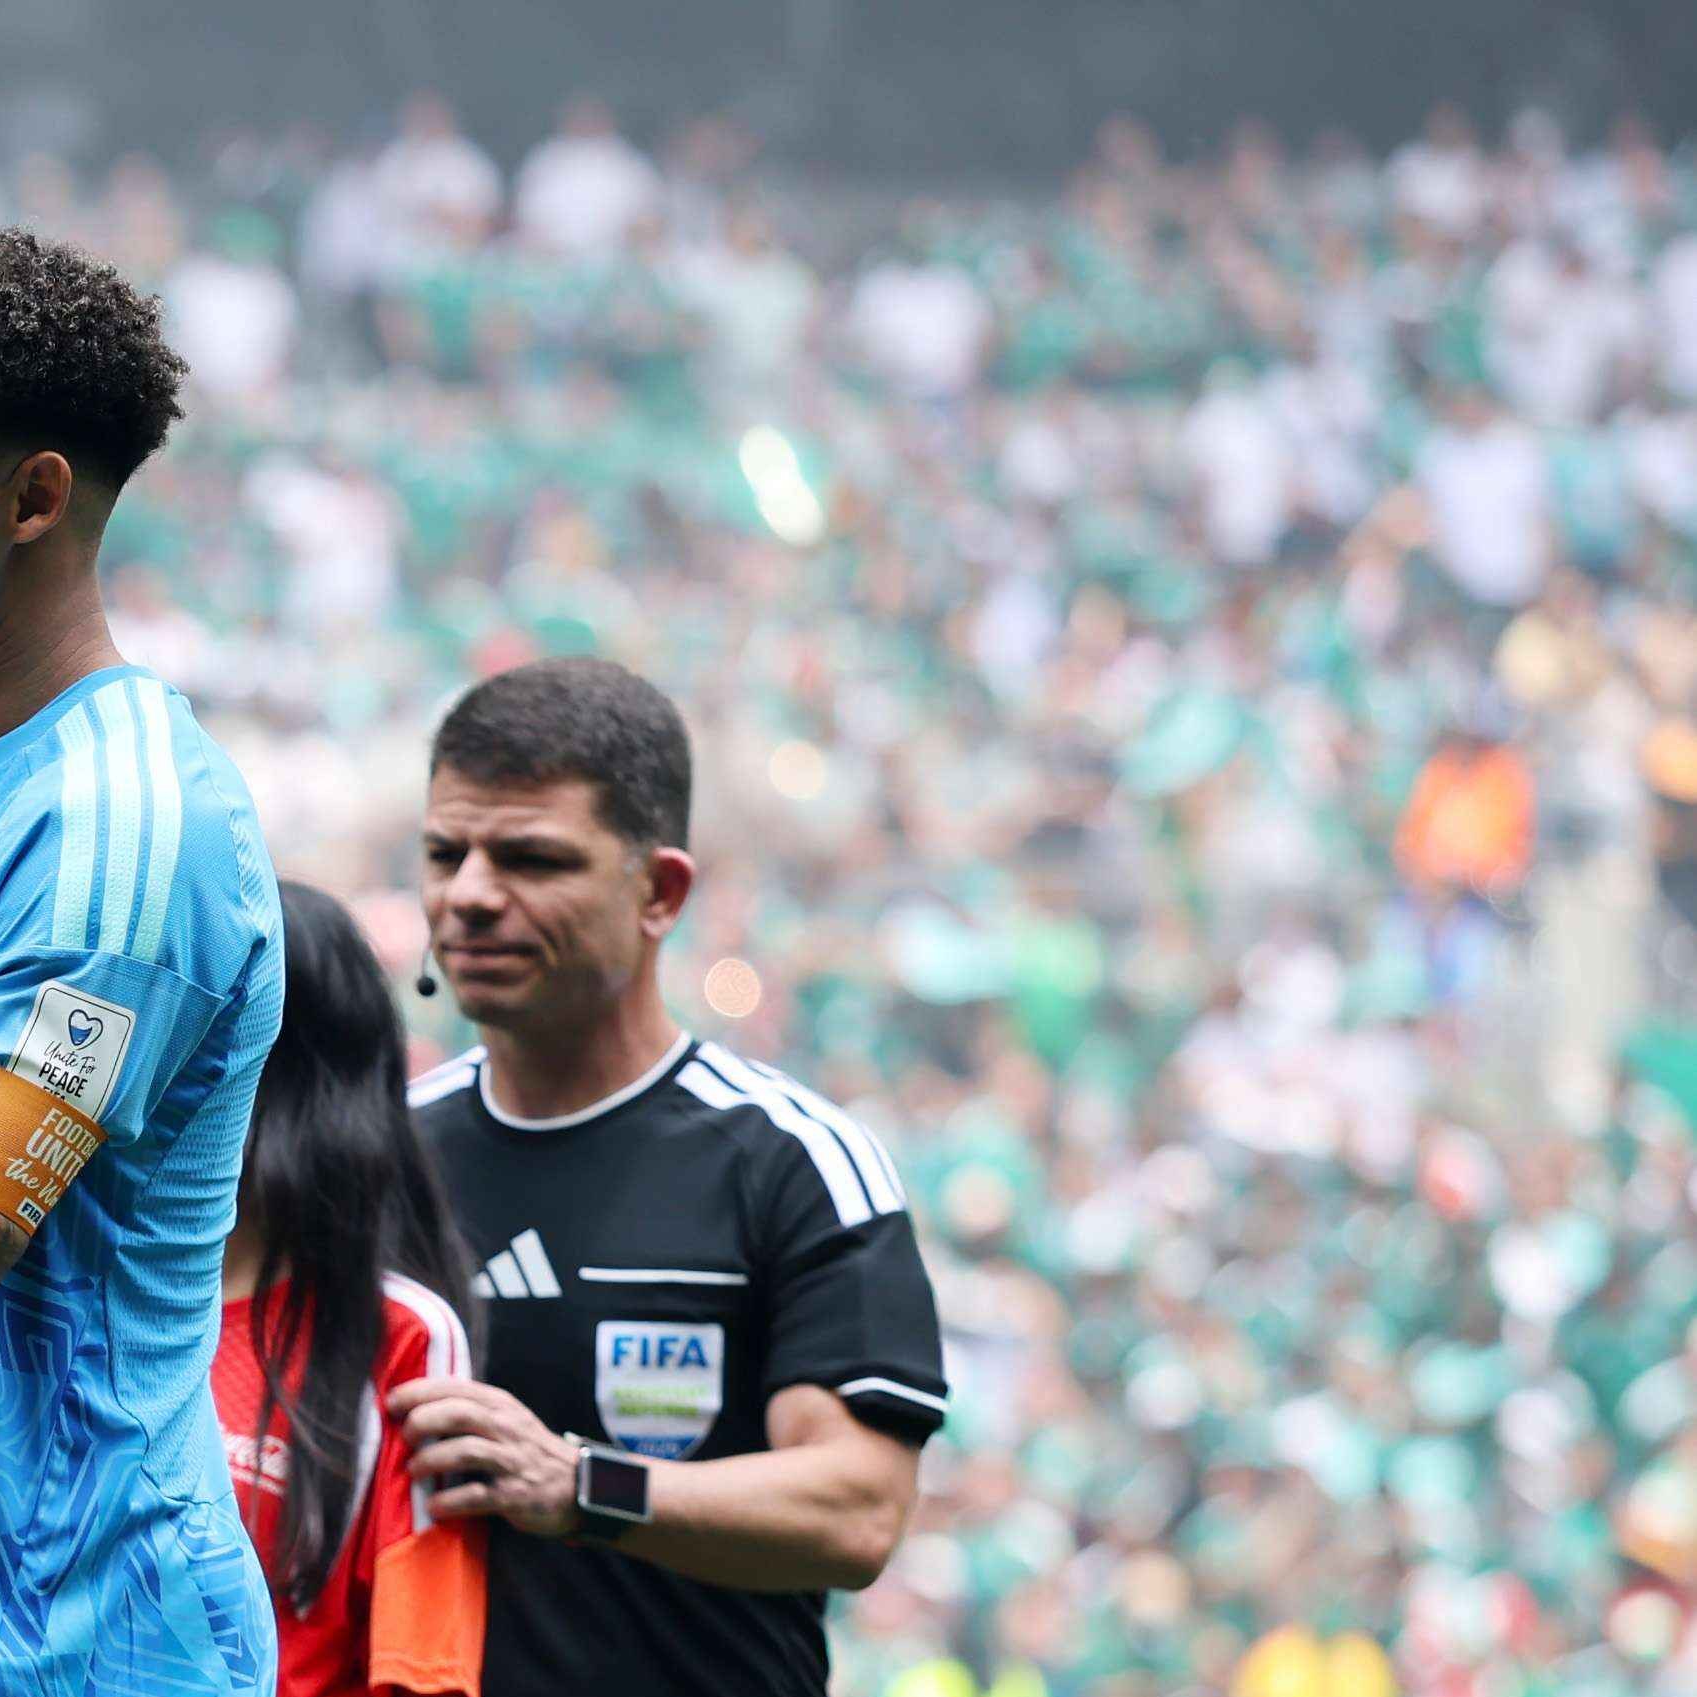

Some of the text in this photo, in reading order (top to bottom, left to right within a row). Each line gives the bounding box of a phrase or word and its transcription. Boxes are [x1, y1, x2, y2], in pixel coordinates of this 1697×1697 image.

[44, 1040, 78, 1067] Unite
[38, 1061, 88, 1098] PEACE
[5, 1157, 40, 1189] the
[612, 1335, 709, 1368] FIFA
